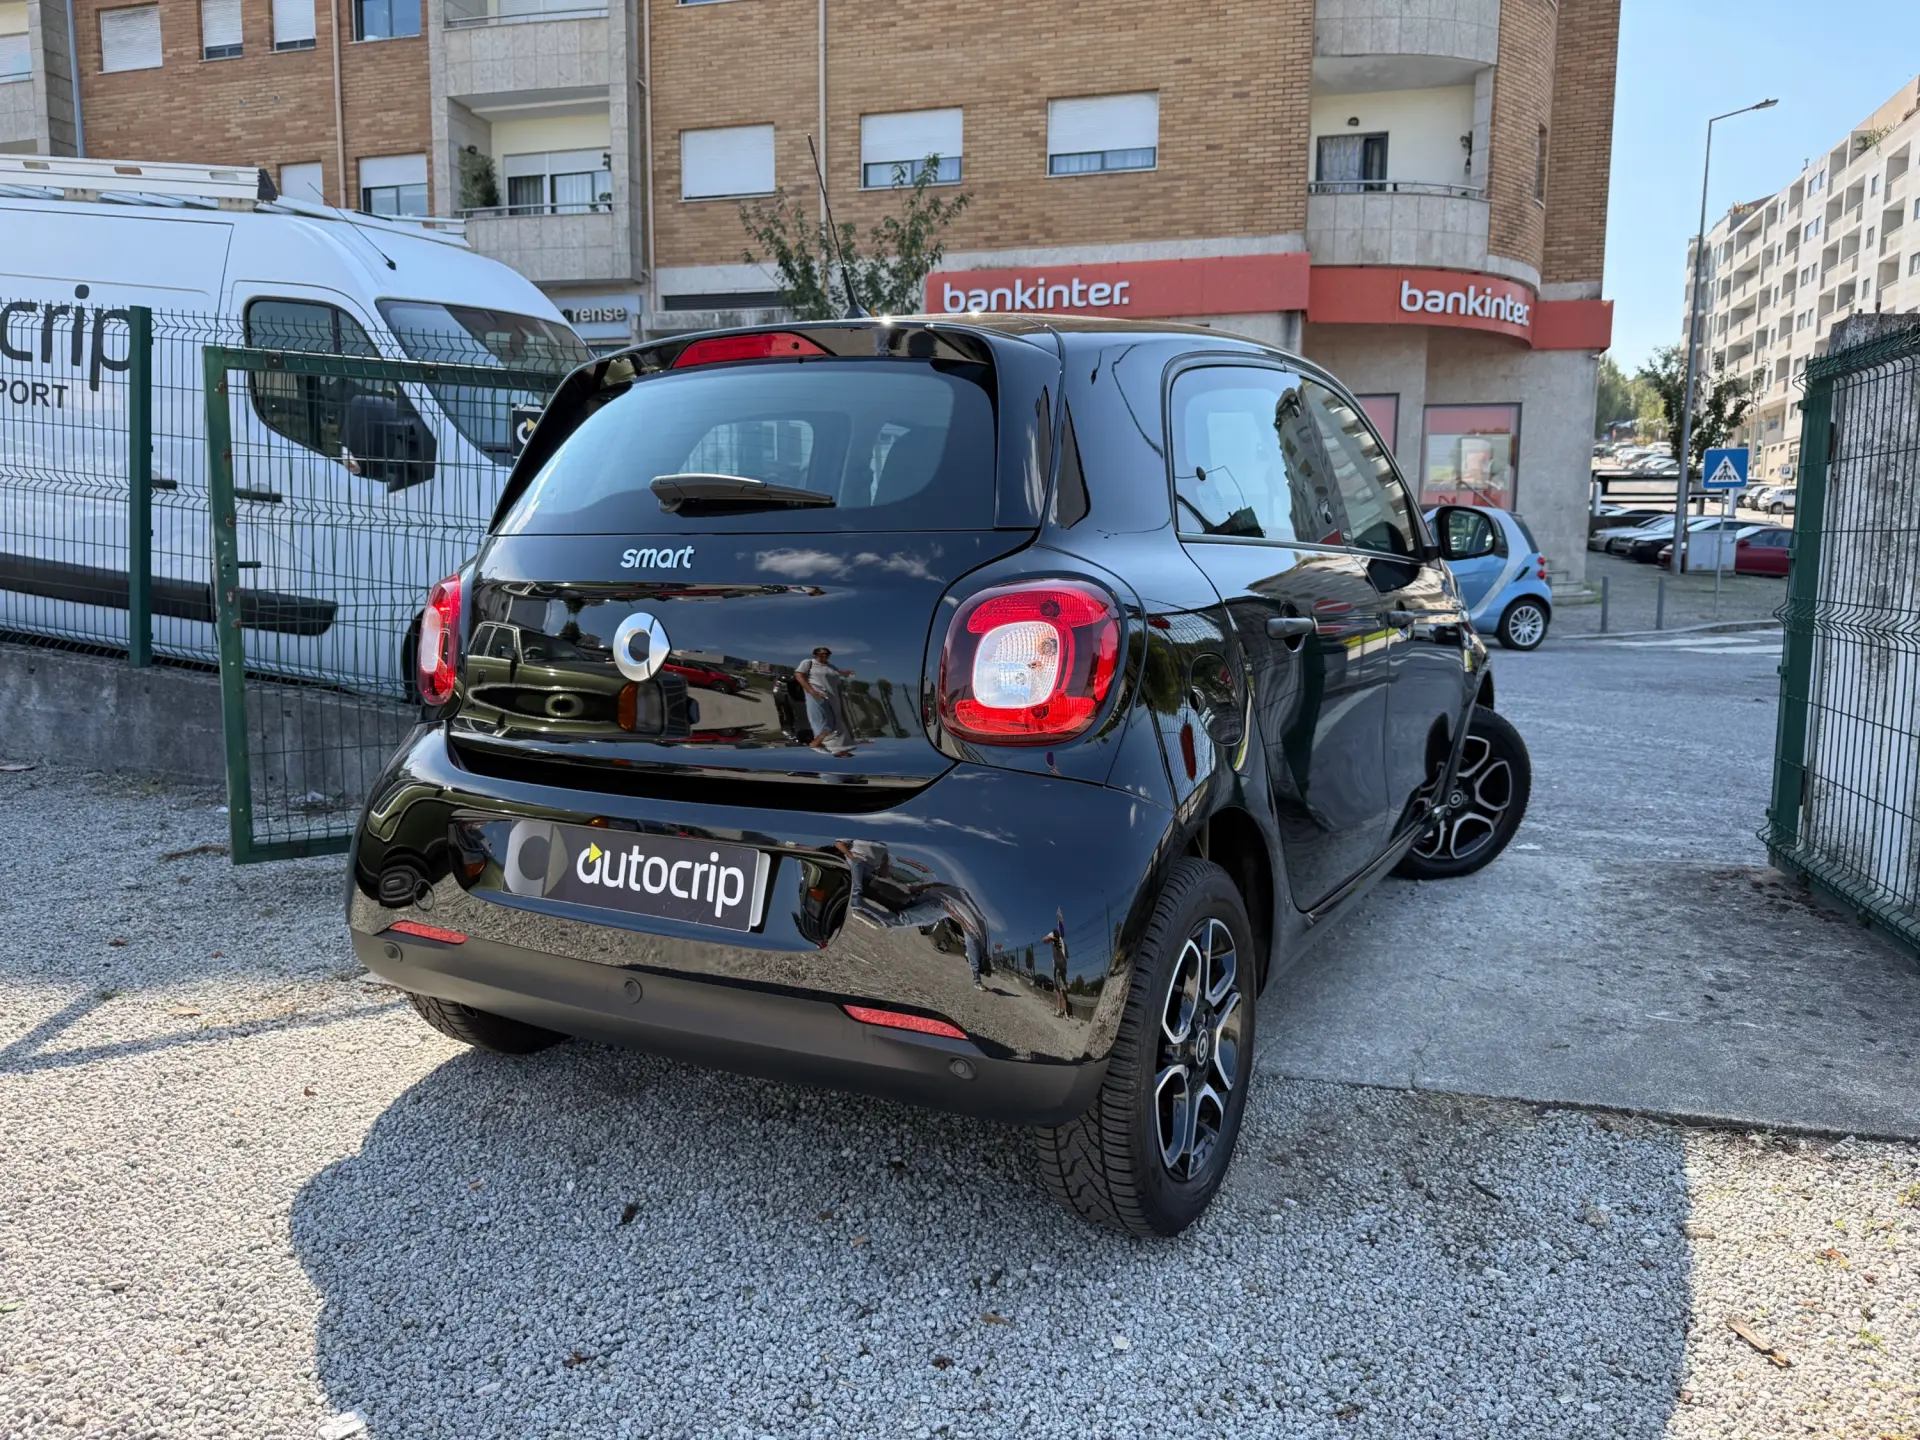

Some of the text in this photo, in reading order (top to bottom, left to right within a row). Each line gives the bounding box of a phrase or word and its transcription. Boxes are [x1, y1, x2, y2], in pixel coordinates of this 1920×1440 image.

[944, 277, 1129, 313] bankinter.
[1401, 280, 1529, 326] bankinter.
[620, 546, 694, 568] smart
[576, 844, 744, 918] autocrip
